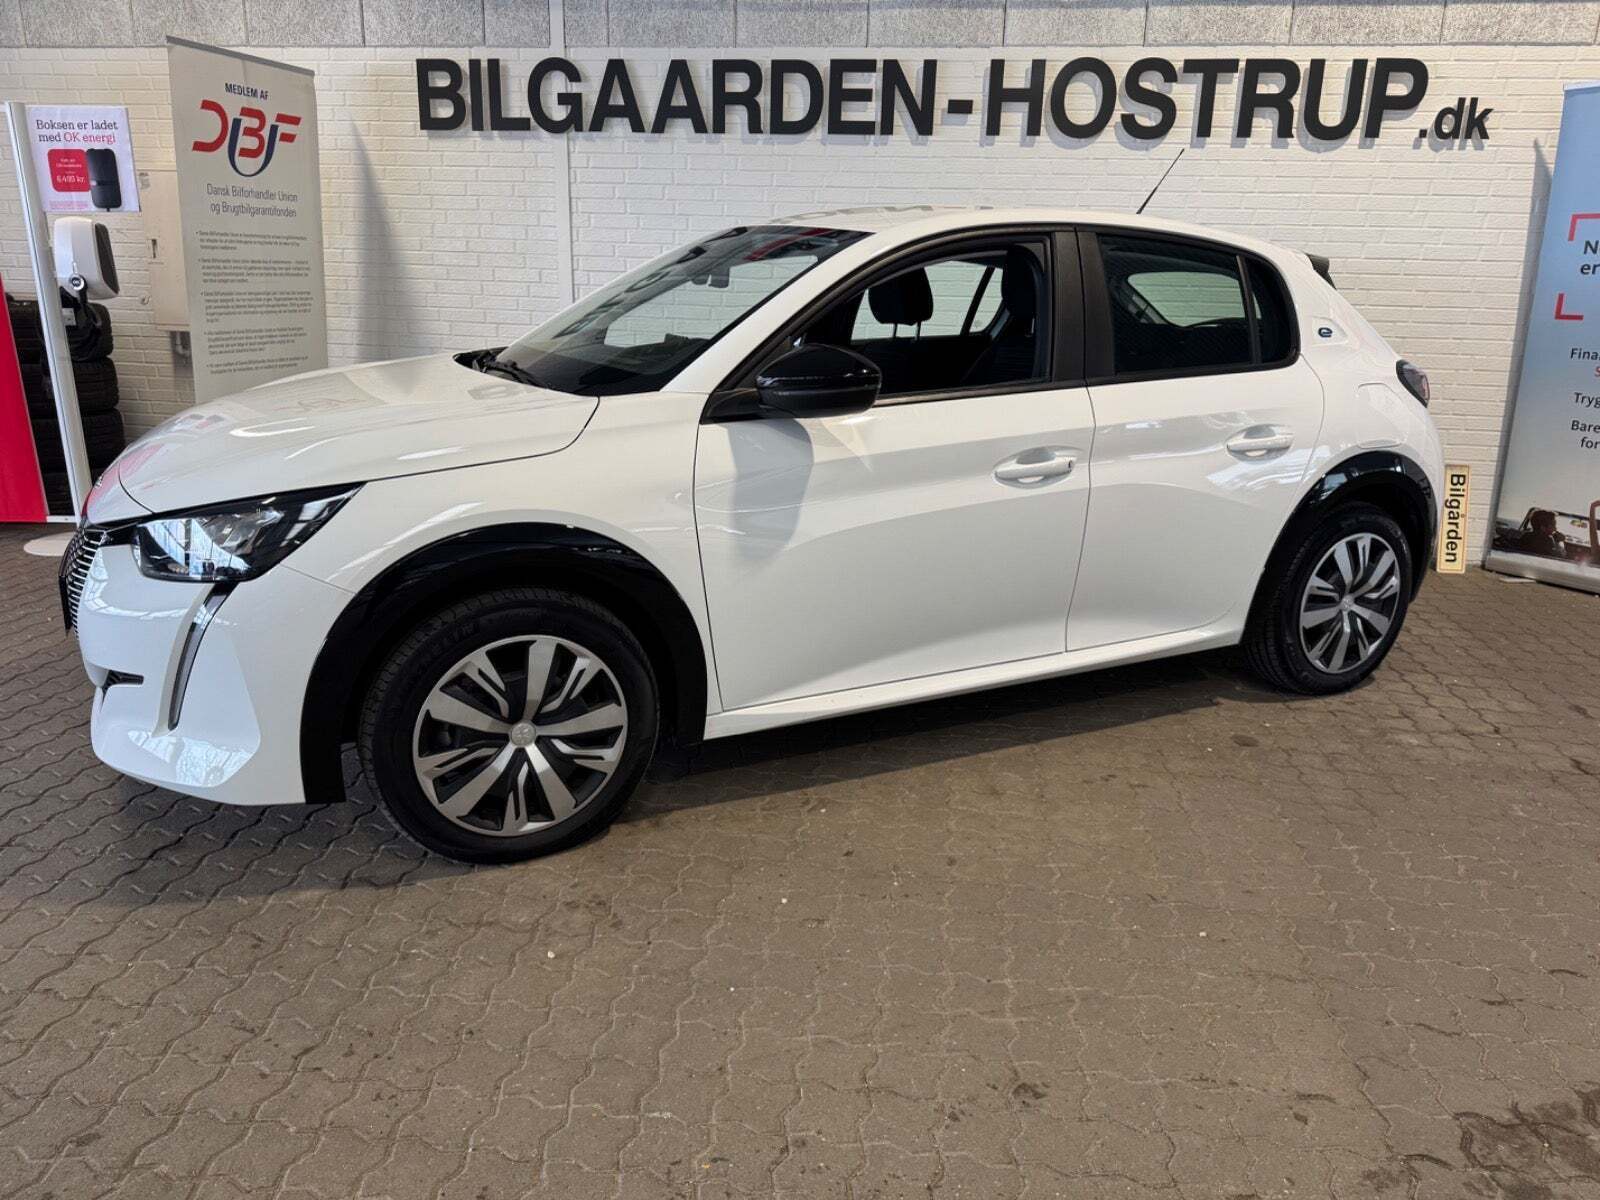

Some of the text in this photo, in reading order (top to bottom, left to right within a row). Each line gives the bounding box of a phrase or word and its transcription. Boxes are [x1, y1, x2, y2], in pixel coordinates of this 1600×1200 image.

[225, 83, 269, 100] MEDLEM AF
[36, 119, 119, 130] Boksen er ladet
[38, 132, 116, 145] med OK energi
[206, 183, 298, 202] Dansk Bilforhandler Union
[210, 203, 221, 216] og
[1584, 239, 1600, 255] N
[1570, 347, 1600, 361] Fina
